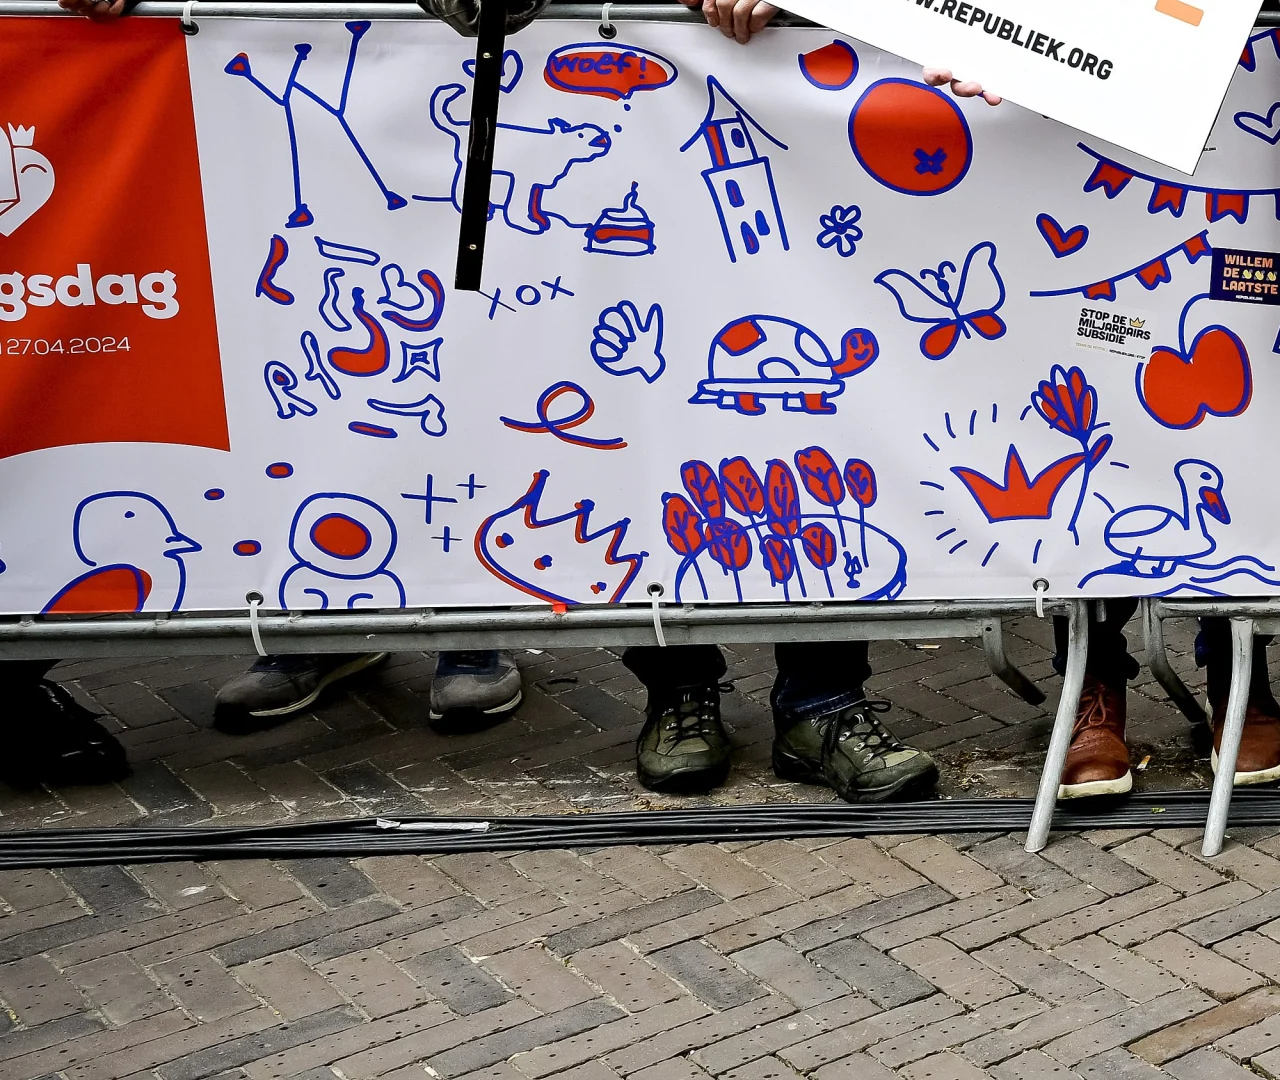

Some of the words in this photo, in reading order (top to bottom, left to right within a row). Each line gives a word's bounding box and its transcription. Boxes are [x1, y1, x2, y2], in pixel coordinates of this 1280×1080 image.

[1225, 254, 1273, 269] WILLEM
[1223, 266, 1240, 278] DE
[1222, 279, 1279, 295] LAATSTE
[1080, 307, 1110, 322] STOP
[1111, 313, 1128, 326] DE
[1076, 326, 1127, 345] SUBSIDIE
[1078, 317, 1151, 341] MILJARDAIRS
[6, 336, 132, 355] 27.04.2024
